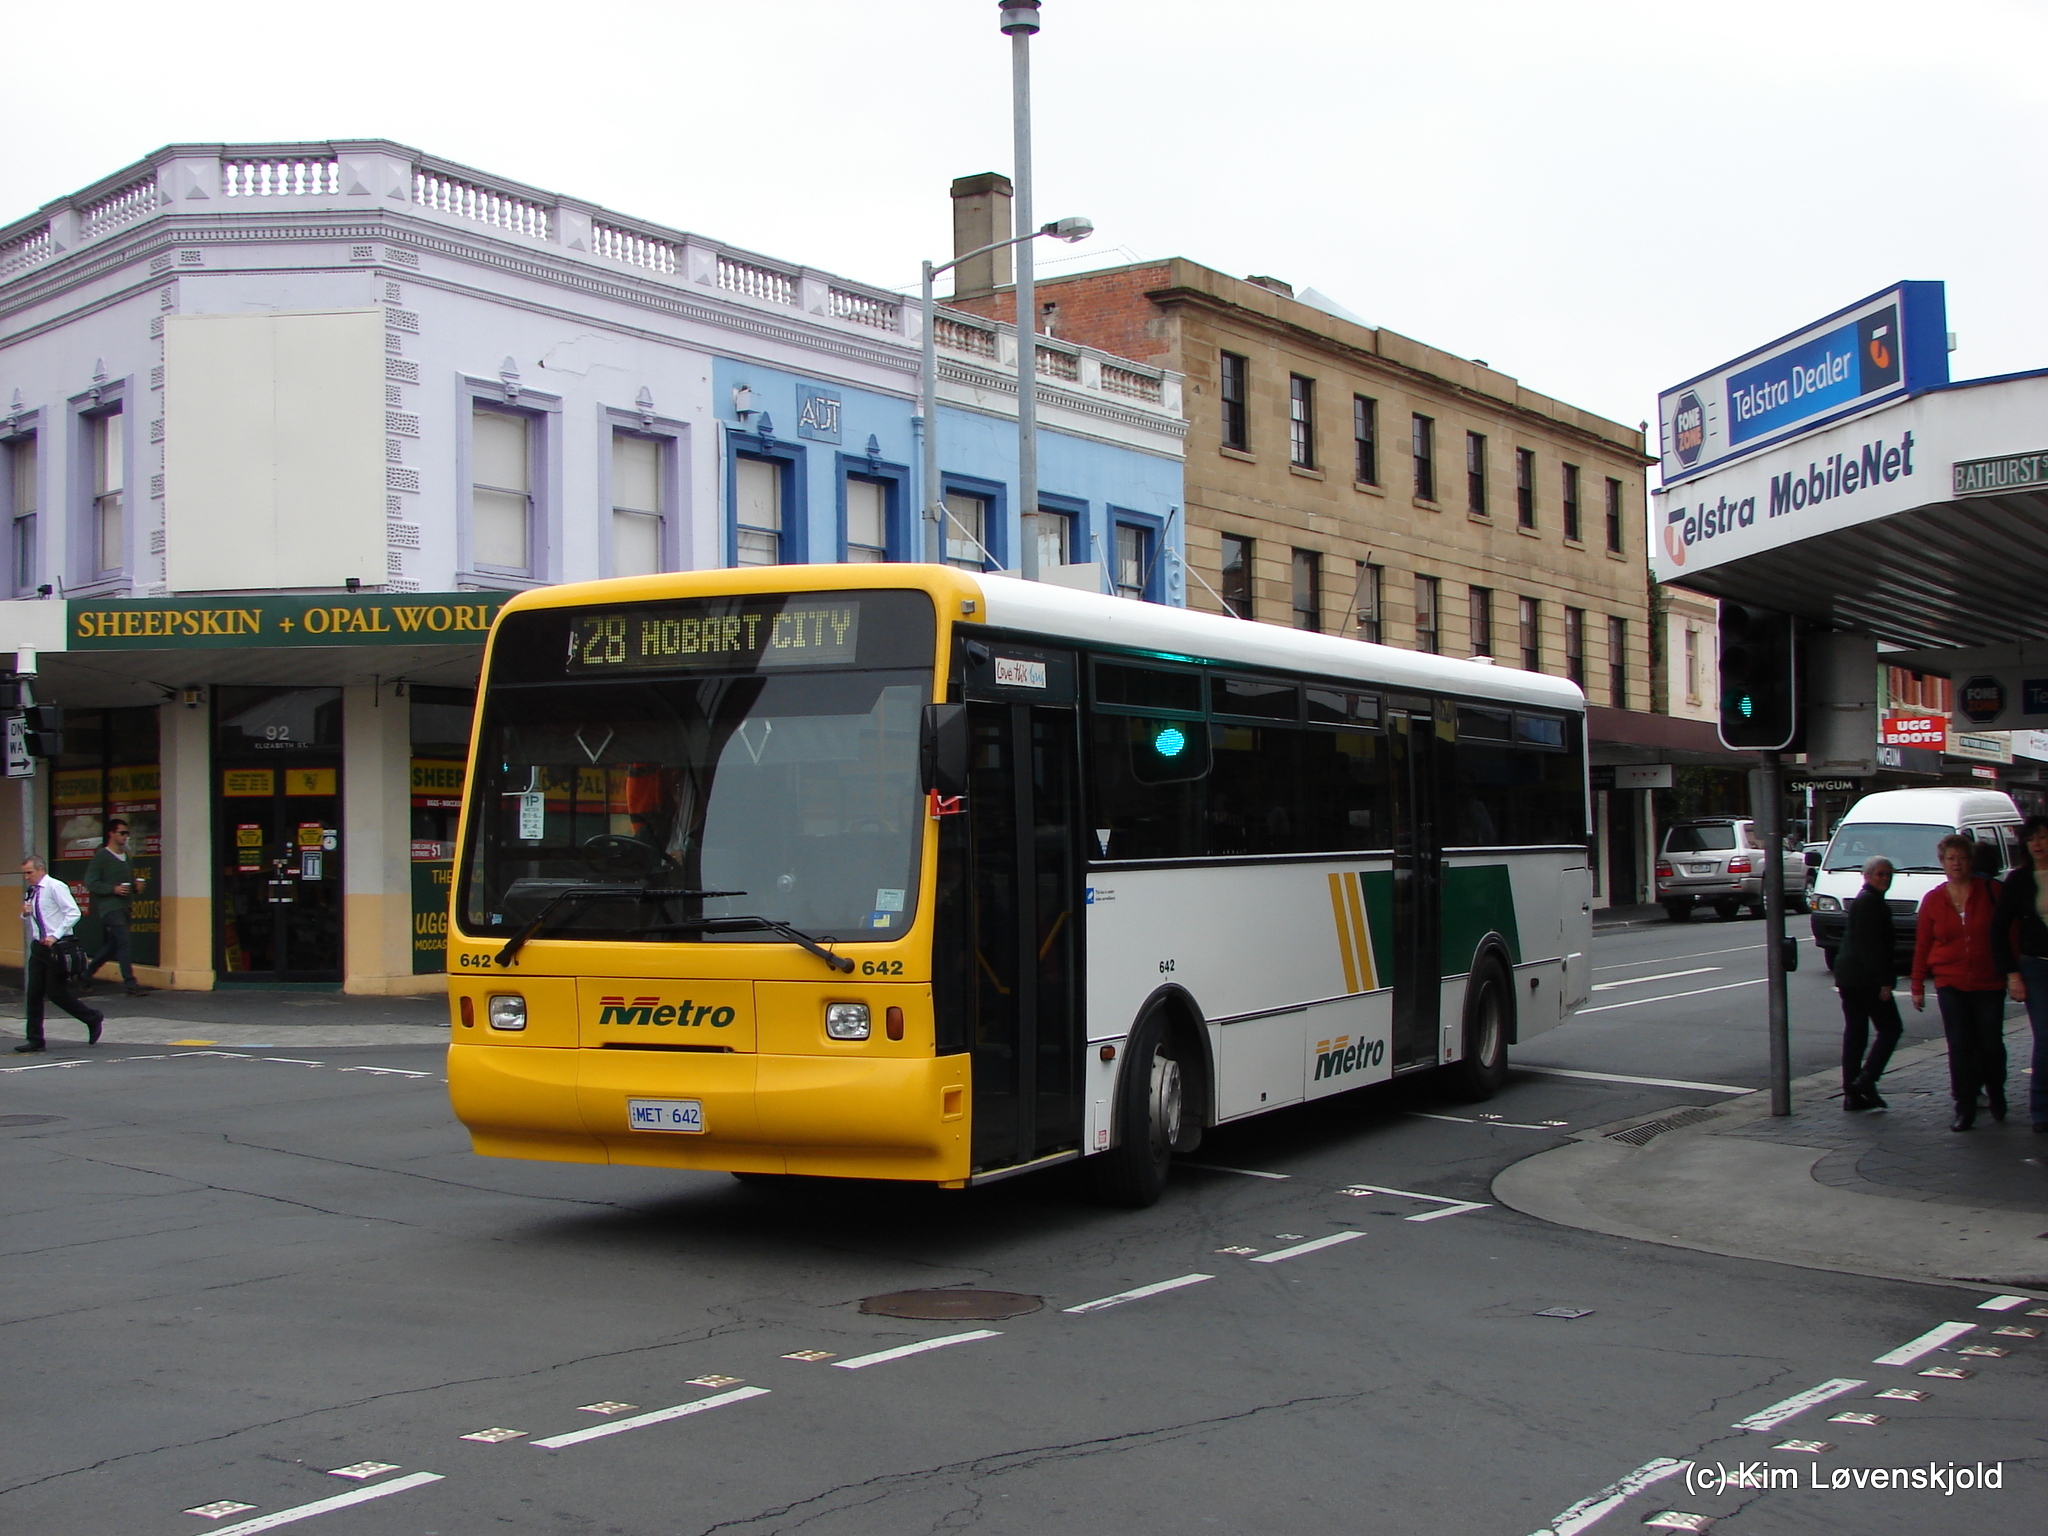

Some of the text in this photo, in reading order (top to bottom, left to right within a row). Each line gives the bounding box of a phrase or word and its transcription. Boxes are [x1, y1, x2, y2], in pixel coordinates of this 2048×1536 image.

[1732, 351, 1852, 422] Telstra Dealer
[799, 397, 841, 433] ADT
[1677, 406, 1700, 433] FONE
[1678, 426, 1702, 452] ZONE
[1954, 455, 2048, 490] BATHURST S
[1664, 430, 1914, 566] Telstra MobileNet
[77, 609, 262, 637] SHEEPSKIN
[304, 607, 391, 634] OPAL
[392, 605, 504, 632] WORL
[583, 609, 850, 664] 28 HOBART CITY
[1966, 687, 1999, 700] FONE
[2029, 687, 2048, 704] Te
[266, 726, 290, 741] 92
[1896, 719, 1931, 731] UGG
[254, 742, 295, 750] ELIZABETH
[1886, 731, 1943, 744] BOOTS
[9, 741, 24, 755] WA
[1876, 746, 1902, 767] WGUM
[413, 767, 464, 789] SHEEP
[1791, 780, 1853, 792] SNOWGUM
[431, 843, 441, 857] $1
[432, 869, 453, 884] THE
[131, 900, 160, 919] BOOTS
[415, 911, 447, 935] UGG
[414, 939, 447, 951] MOCCAS
[460, 953, 491, 969] 642
[861, 960, 903, 976] 642
[1159, 959, 1175, 974] 642
[598, 996, 735, 1027] Metro
[1314, 1035, 1384, 1081] Metro
[636, 1107, 700, 1124] MET 642
